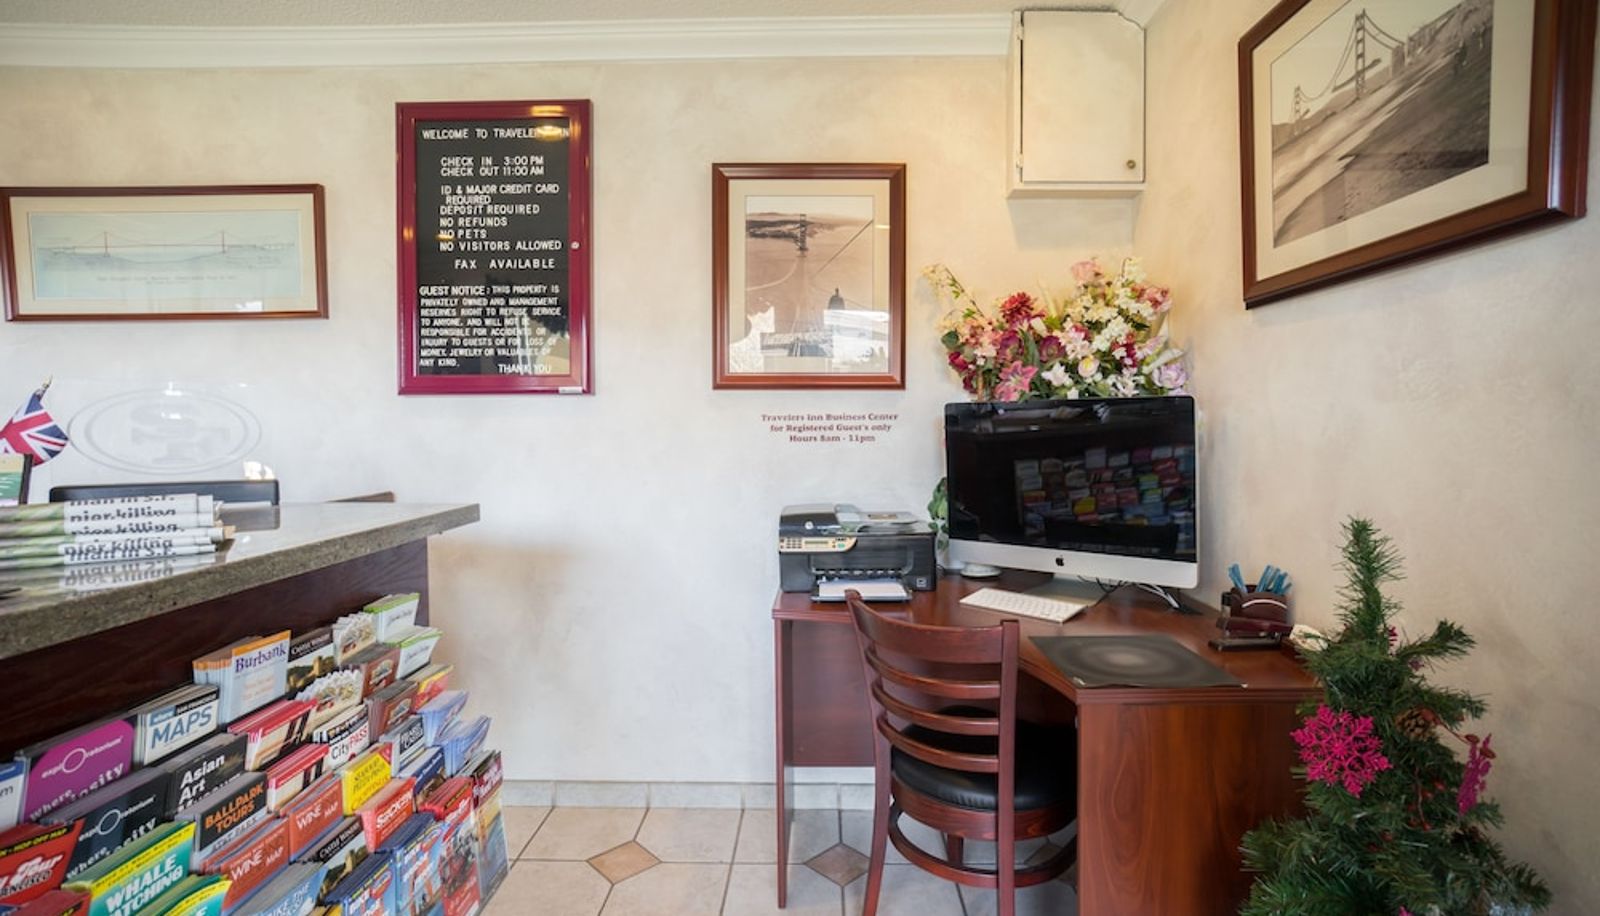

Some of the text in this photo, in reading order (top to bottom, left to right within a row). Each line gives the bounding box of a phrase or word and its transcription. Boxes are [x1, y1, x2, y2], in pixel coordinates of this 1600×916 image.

[422, 128, 468, 139] WELCOME
[476, 129, 488, 139] TO
[493, 127, 548, 139] TRAVELE
[440, 156, 544, 166] CHECK IN 3:00 PM
[440, 167, 544, 177] CHECK OUT 11:00 AM
[441, 184, 559, 195] ID & MAJOR CREDIT CARD
[445, 195, 491, 205] REQUIRED
[440, 204, 540, 215] DEPOSIT REQUIRED
[439, 217, 508, 227] NO REFUNDS
[439, 229, 487, 239] NO PETS
[439, 240, 562, 251] NO VISITORS ALLOWED
[455, 258, 555, 269] FAX AVAILABLE
[419, 285, 449, 296] GUEST
[492, 285, 510, 294] THIS
[512, 285, 547, 294] PROPERTY
[551, 284, 559, 293] IS
[462, 297, 488, 306] OWNED
[489, 297, 505, 306] AND
[508, 297, 558, 306] MANAGEMENT
[421, 307, 561, 317] RESERVES RIGHT TO REFUSE SERVICE
[421, 317, 431, 326] TO
[467, 317, 482, 326] AND
[485, 317, 502, 326] WILL
[421, 328, 471, 337] RESPONSIBLE
[473, 327, 488, 336] FOR
[451, 338, 461, 346] TO
[463, 338, 492, 347] GUESTS
[494, 338, 506, 346] OR
[449, 348, 483, 357] JEWELRY
[484, 347, 495, 357] OR
[497, 347, 538, 356] VALUES
[420, 358, 435, 367] ANY
[761, 412, 899, 422] Travelers Inn Business Center
[770, 424, 892, 433] for Registered Guest's only
[790, 434, 817, 443] Hours
[849, 434, 876, 443] 11pm
[235, 643, 286, 673] Burbank
[151, 705, 212, 749] MAPS
[180, 755, 225, 789] Asian
[179, 778, 205, 805] Art
[205, 781, 263, 829] BALLPARK
[216, 801, 255, 833] TOURS
[296, 803, 321, 829] WINE
[230, 846, 284, 880] WINE MAP
[106, 854, 177, 913] WHALE
[109, 865, 183, 916] ATCHING
